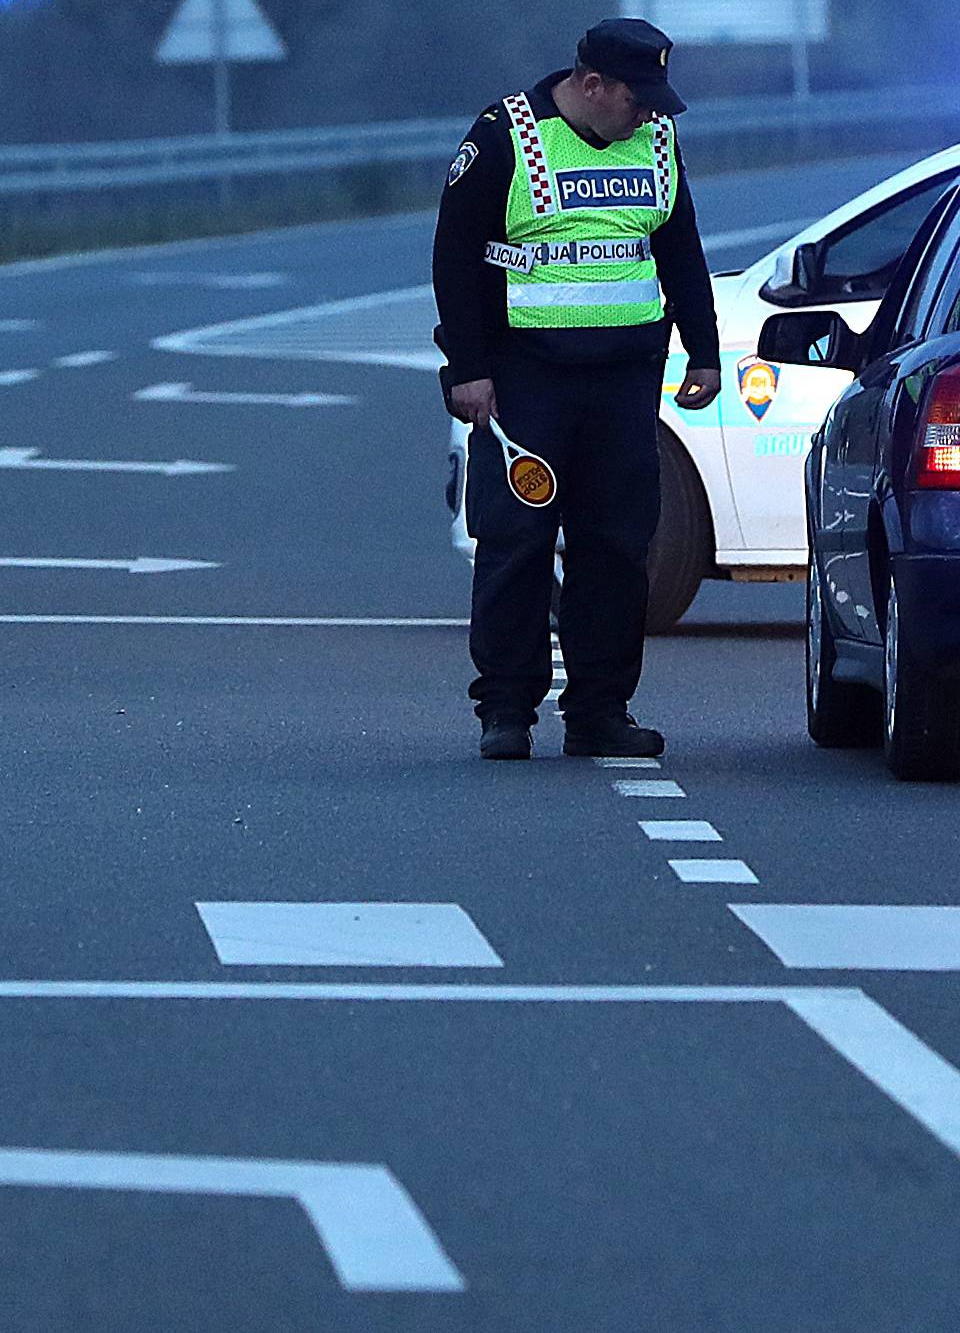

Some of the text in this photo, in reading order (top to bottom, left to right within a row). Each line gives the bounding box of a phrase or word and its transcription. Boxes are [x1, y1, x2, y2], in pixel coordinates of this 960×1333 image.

[561, 178, 654, 200] POLICIJA
[579, 243, 642, 260] POLICIJA
[524, 473, 548, 496] STOP
